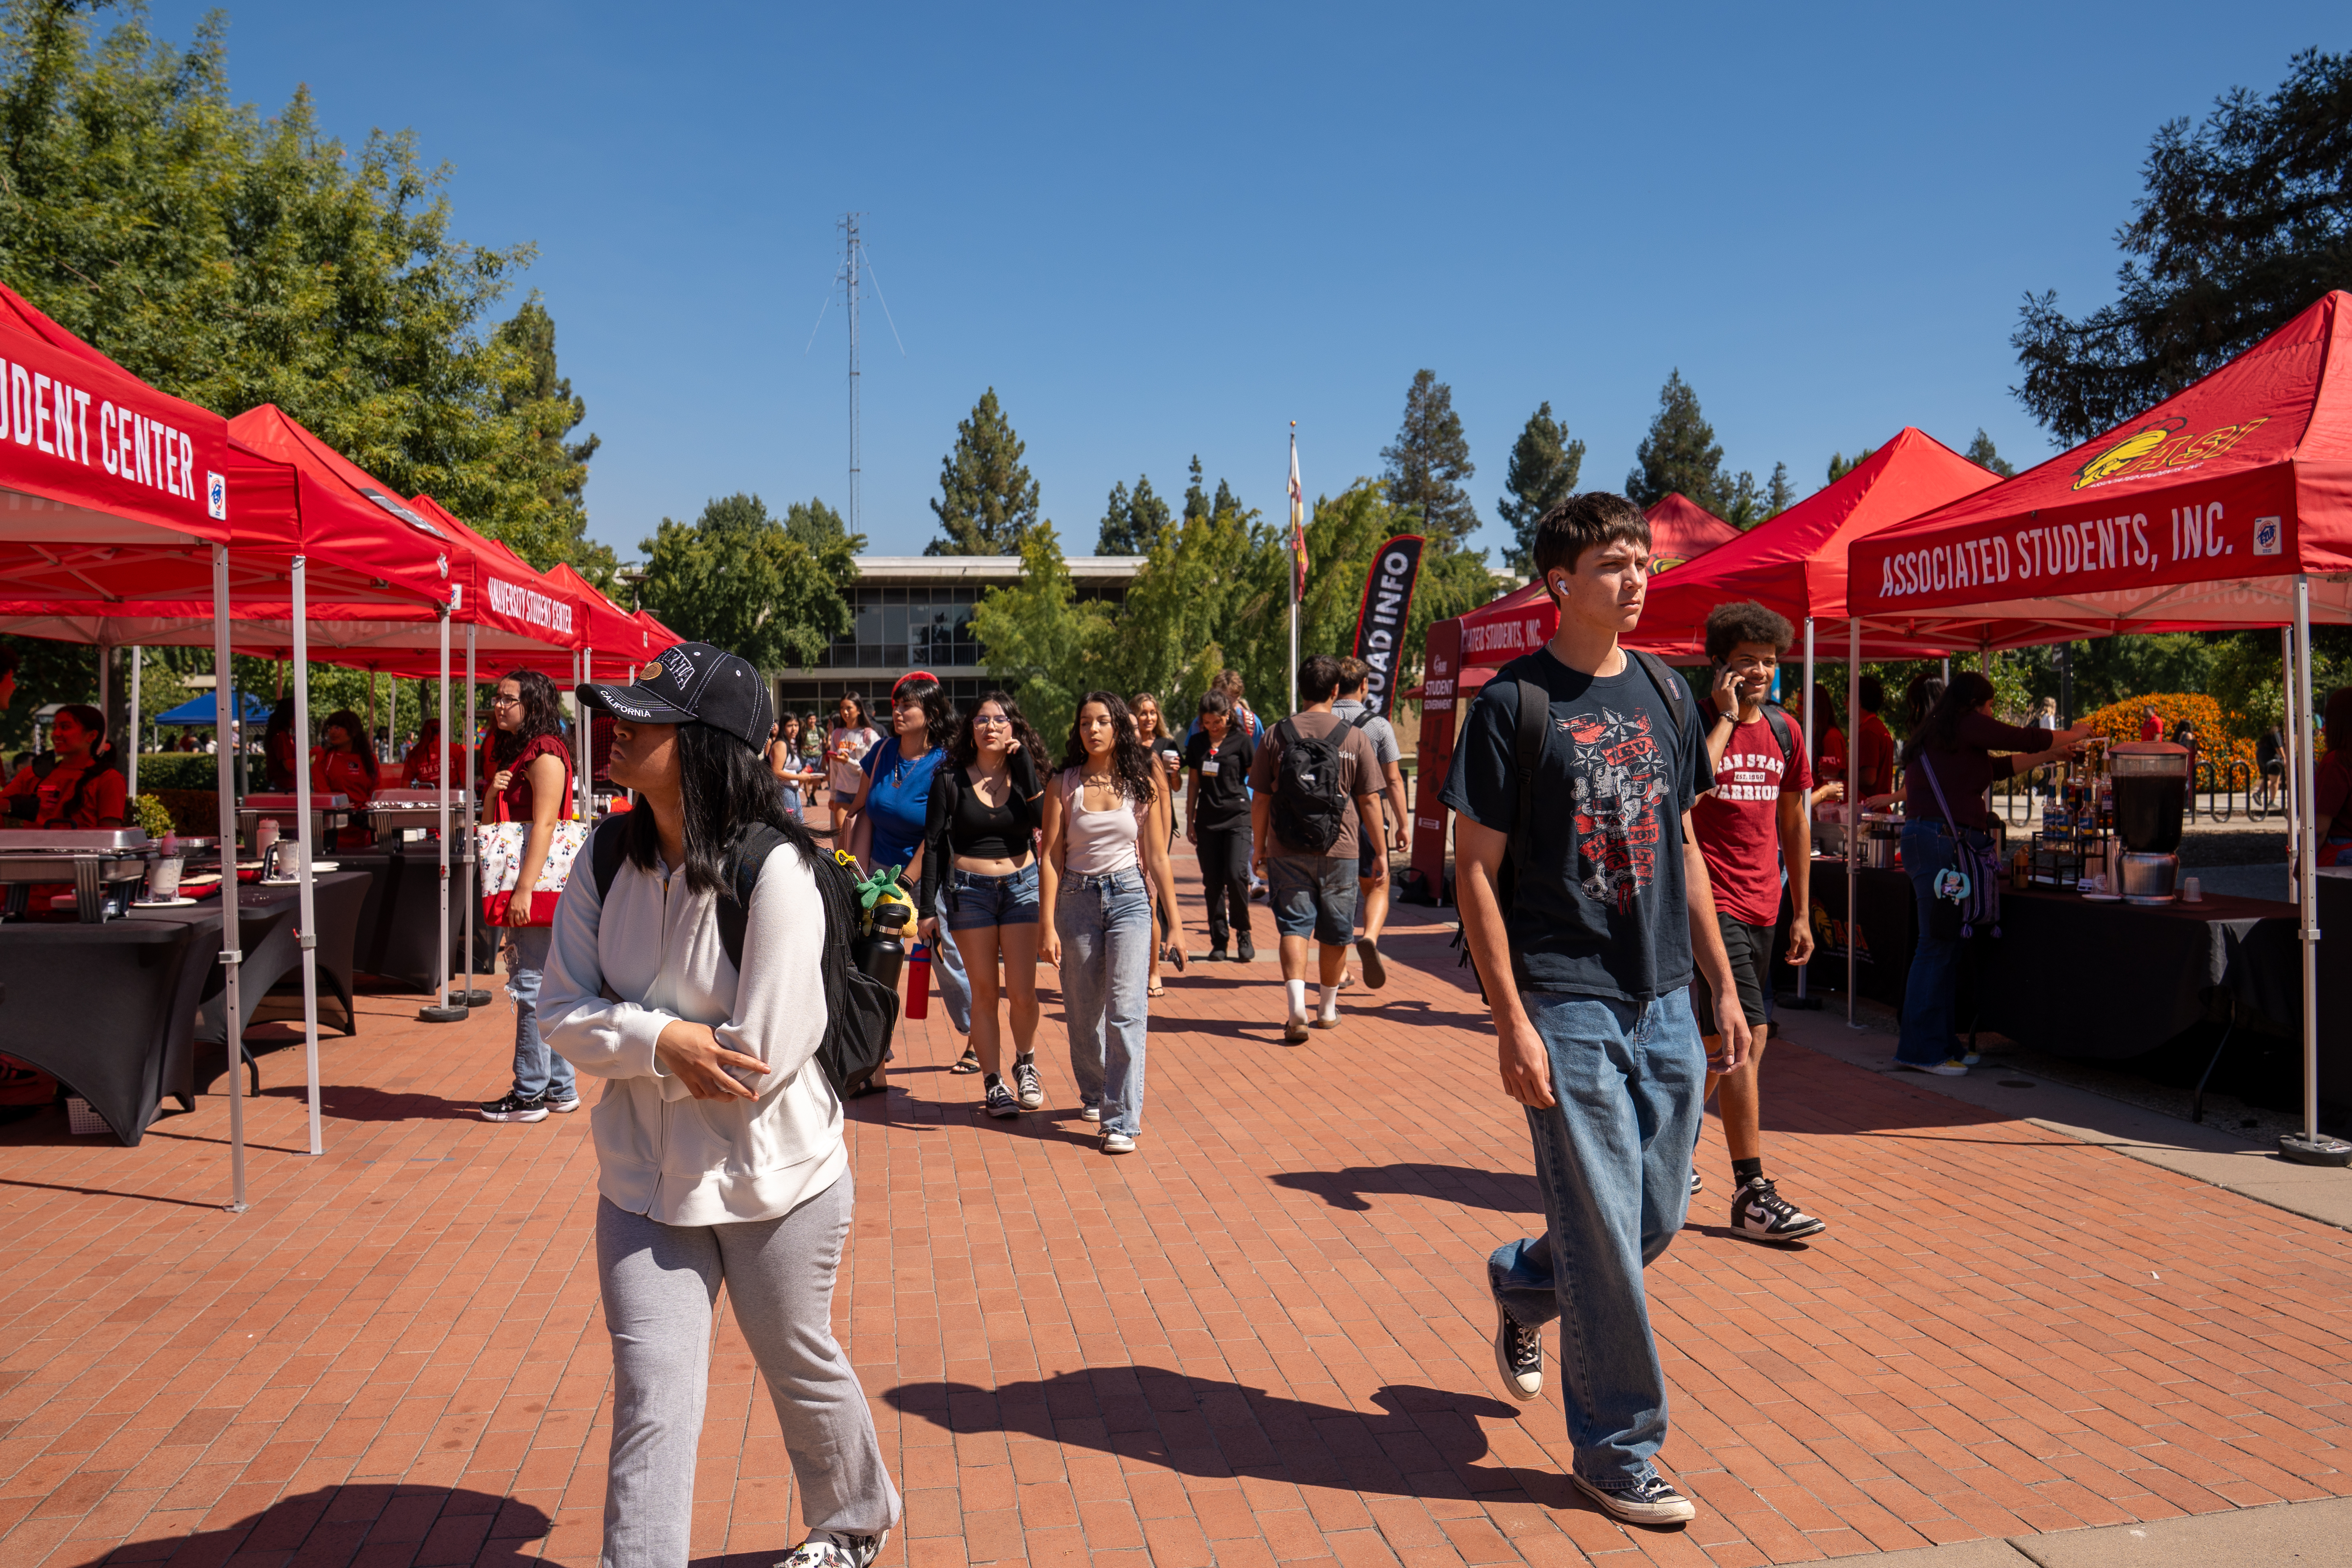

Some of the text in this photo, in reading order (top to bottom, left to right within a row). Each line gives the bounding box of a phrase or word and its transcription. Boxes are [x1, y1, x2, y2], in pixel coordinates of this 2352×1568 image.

[100, 400, 195, 501] CENTER
[1879, 535, 2010, 598] ASSOCIATED
[2015, 512, 2157, 579] STUDENTS,
[2171, 501, 2233, 562] INC.
[488, 576, 527, 620] UNIVERSITY
[526, 589, 552, 628] STUDENT
[551, 599, 573, 635] CENTER
[1373, 551, 1409, 625] INFO
[1485, 620, 1525, 651] STUDENTS,
[1526, 618, 1544, 647] INC.
[1365, 629, 1392, 713] QUAD
[1425, 679, 1454, 696] STUDENT
[600, 690, 651, 718] CALIFORNIA
[1424, 699, 1453, 710] GOVERNMENT
